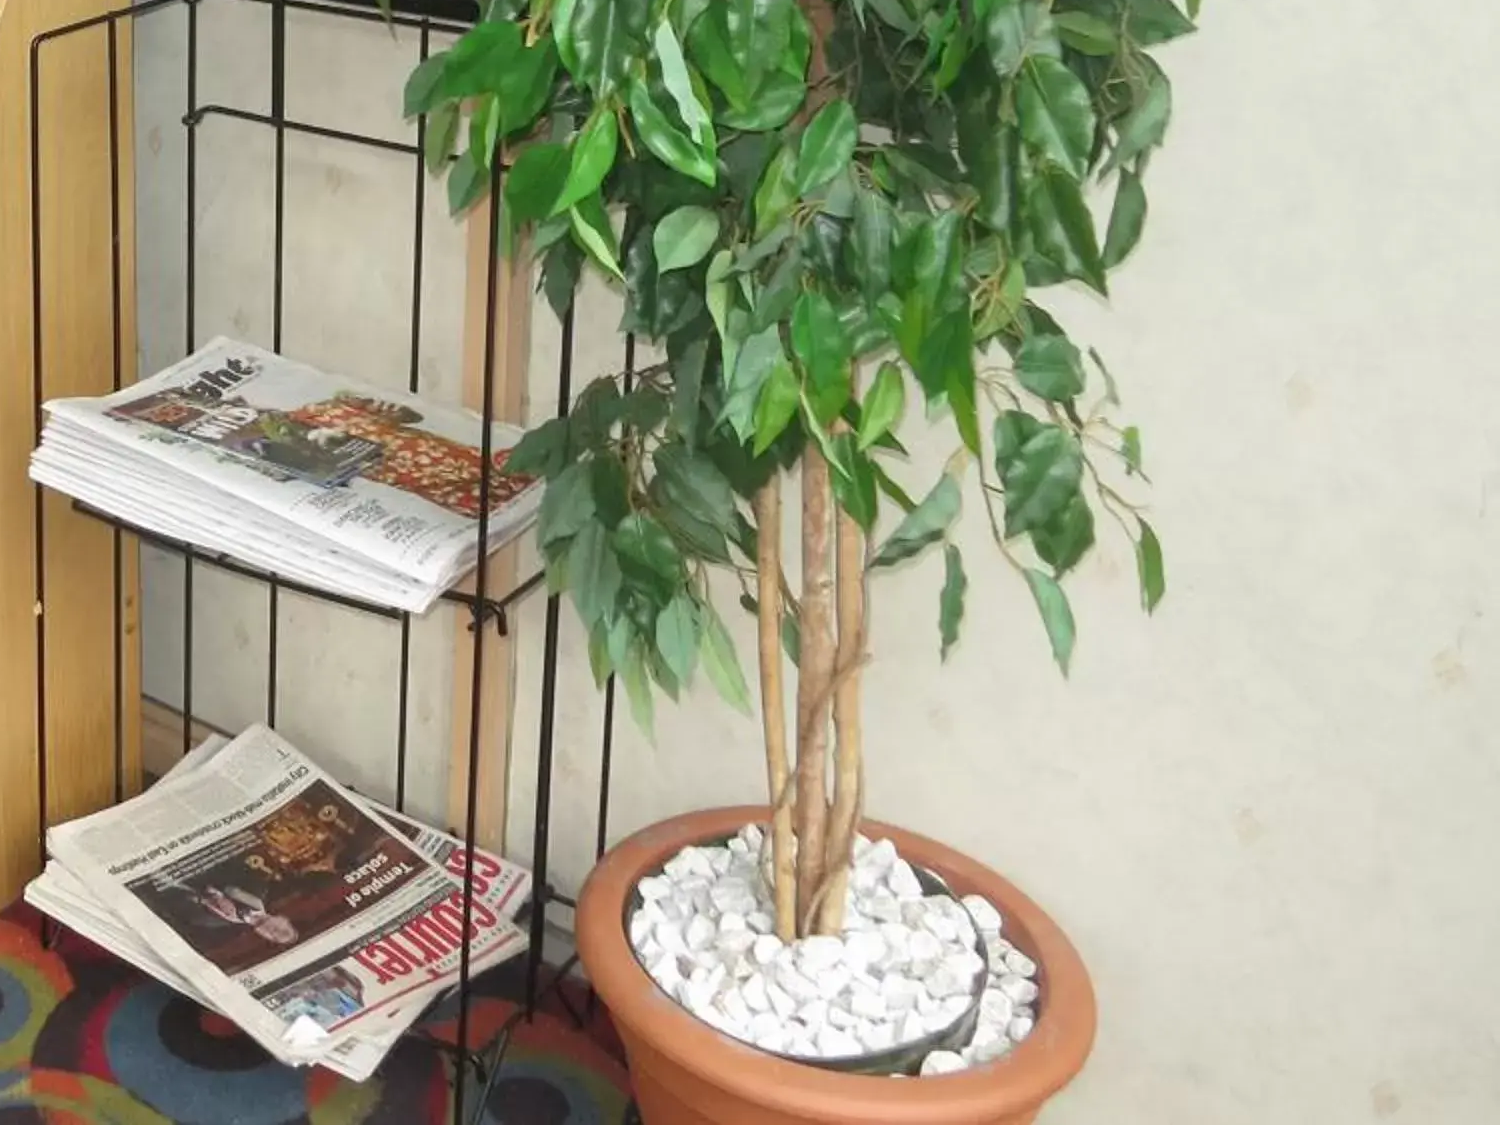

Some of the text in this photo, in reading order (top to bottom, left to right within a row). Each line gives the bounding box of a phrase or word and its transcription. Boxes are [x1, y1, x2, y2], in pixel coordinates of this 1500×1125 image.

[343, 852, 389, 884] solace
[344, 861, 414, 909] Temple of
[353, 889, 497, 985] courier
